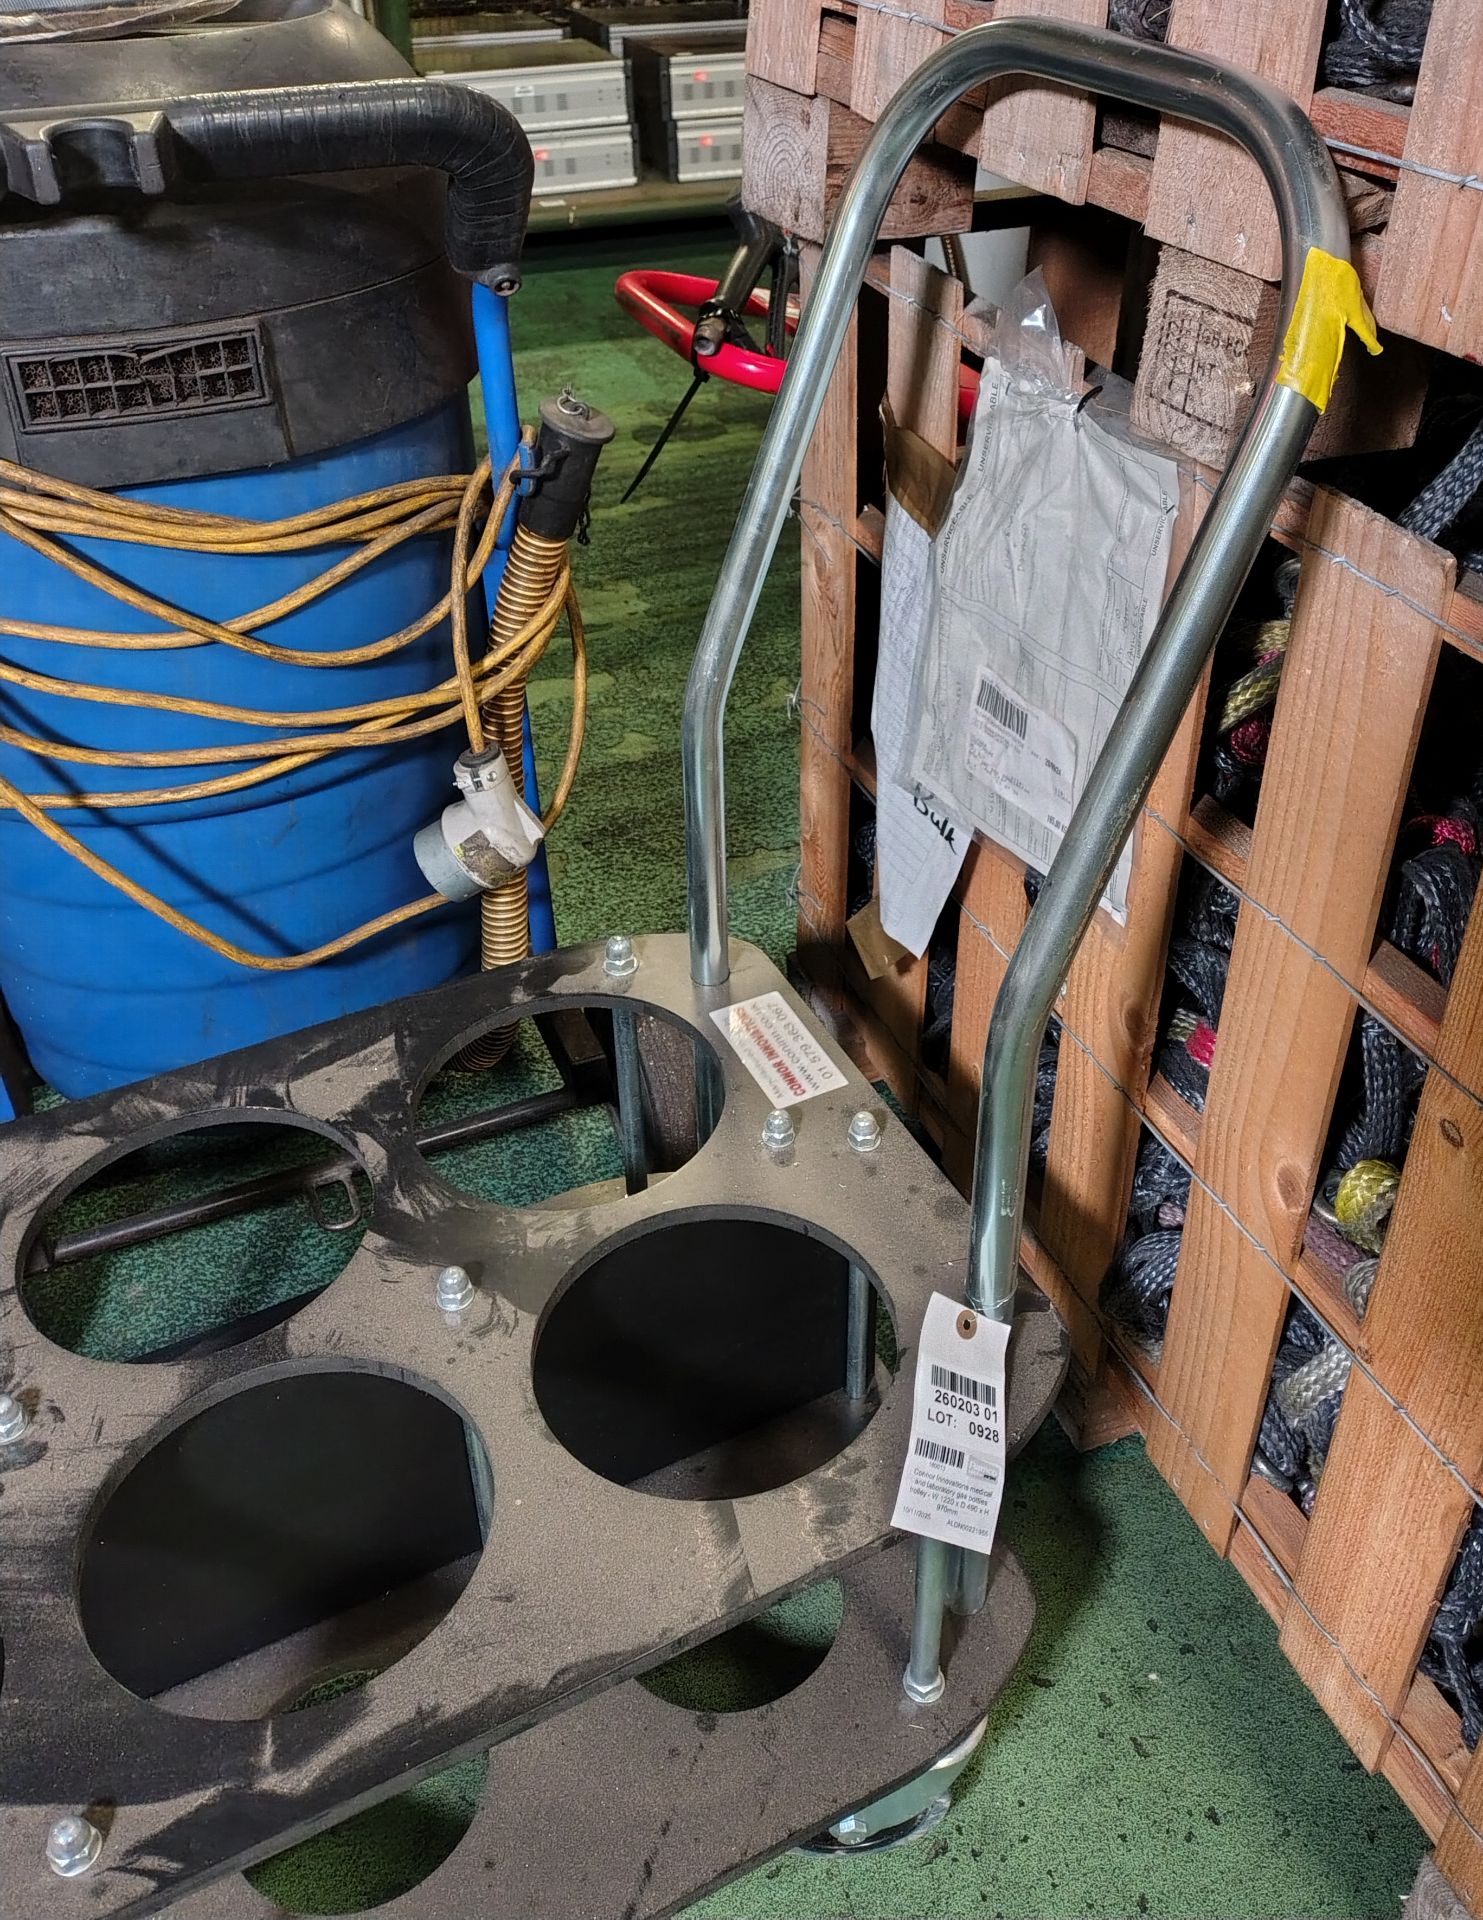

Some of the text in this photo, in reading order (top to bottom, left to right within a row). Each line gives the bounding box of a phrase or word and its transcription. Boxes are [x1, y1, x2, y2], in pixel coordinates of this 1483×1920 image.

[940, 493, 974, 573] UNSERVICEABLE
[914, 783, 957, 855] Bulk
[732, 1006, 779, 1061] INNOVATIONS
[798, 1042, 821, 1065] 579
[771, 1059, 806, 1097] CONNOR
[817, 1065, 833, 1080] 01
[934, 1389, 998, 1423] 260203 01
[927, 1407, 999, 1442] LOT: 0928
[913, 1468, 992, 1497] Connor Innovations medical
[914, 1478, 926, 1486] and
